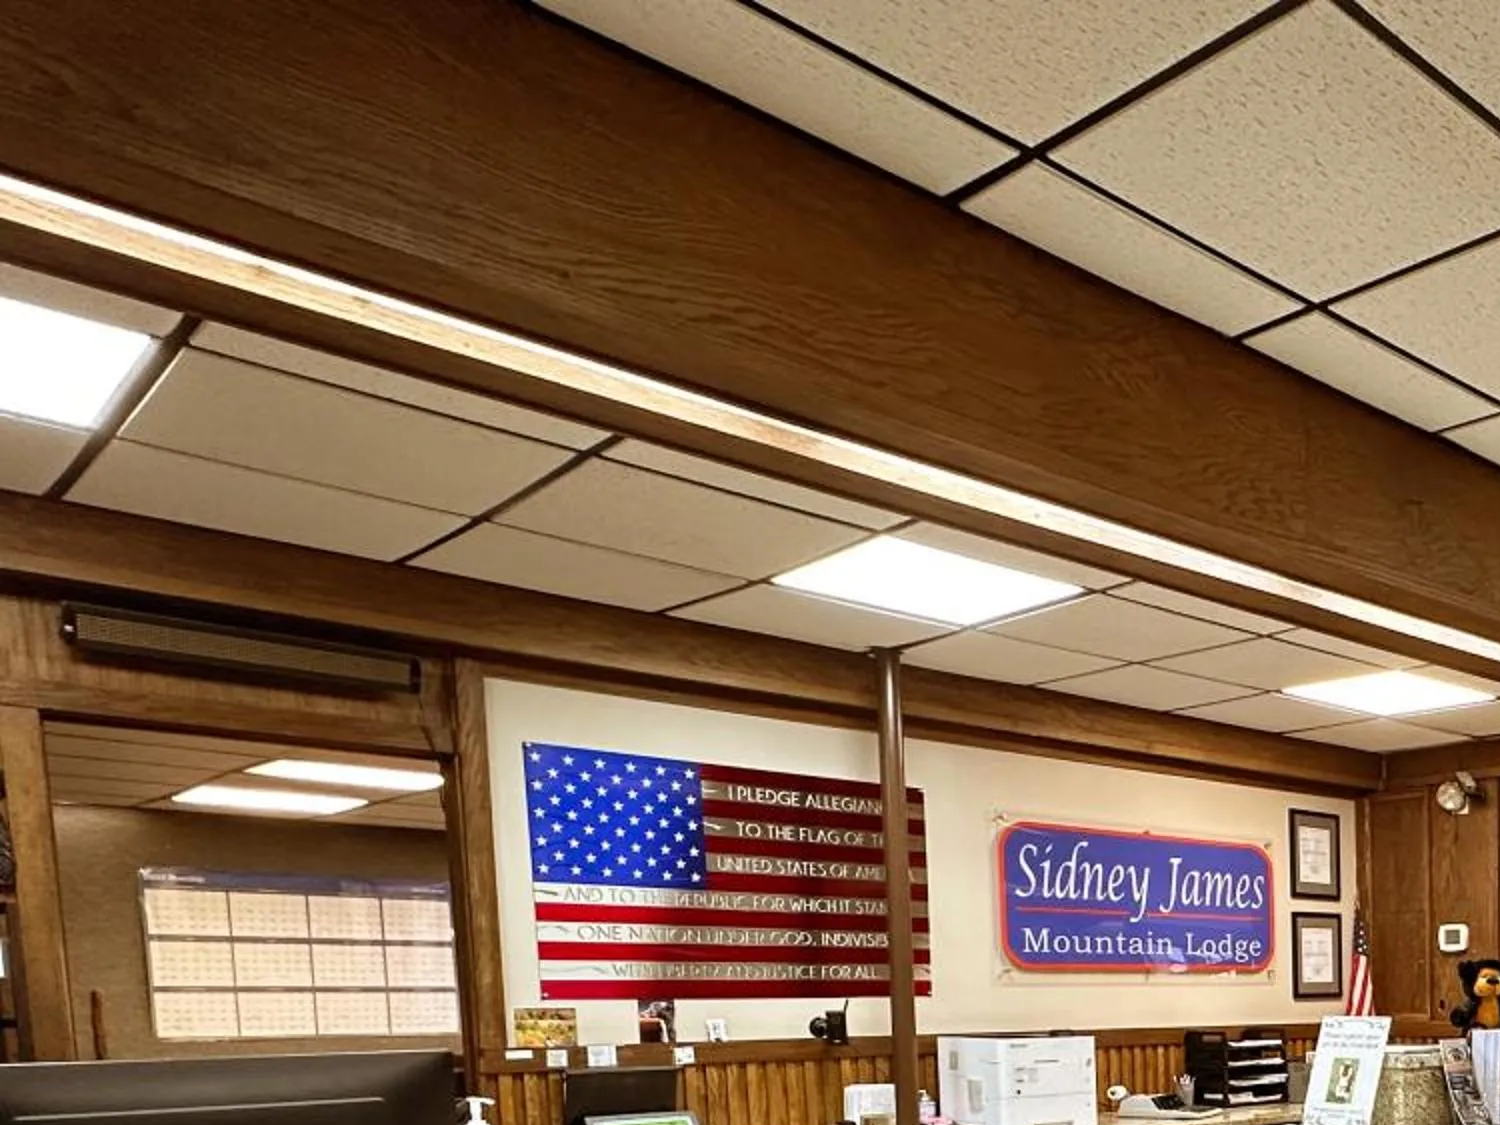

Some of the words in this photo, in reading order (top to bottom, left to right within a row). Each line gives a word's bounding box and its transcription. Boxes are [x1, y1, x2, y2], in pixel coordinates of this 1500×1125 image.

[727, 785, 733, 801] I
[737, 786, 801, 808] PLEDGE
[805, 793, 884, 816] ALLEGIAN
[735, 821, 761, 838] TO
[767, 825, 796, 842] THE
[799, 827, 841, 846] FLAG
[843, 831, 865, 848] OF
[717, 856, 773, 874] UNITED
[777, 860, 828, 878] STATES
[829, 862, 849, 879] OF
[1014, 841, 1151, 923] Sidney
[1159, 856, 1266, 913] James
[563, 886, 604, 902] AND
[610, 888, 637, 903] TO
[753, 895, 785, 912] FOR
[789, 897, 838, 913] WHICH
[839, 898, 852, 913] IT
[577, 925, 623, 941] ONE
[629, 925, 702, 943] NATION
[821, 931, 889, 949] INDIVISIB
[1022, 927, 1173, 955] Mountain
[1185, 932, 1262, 961] Lodge
[822, 965, 851, 979] FOR
[854, 965, 878, 979] ALL
